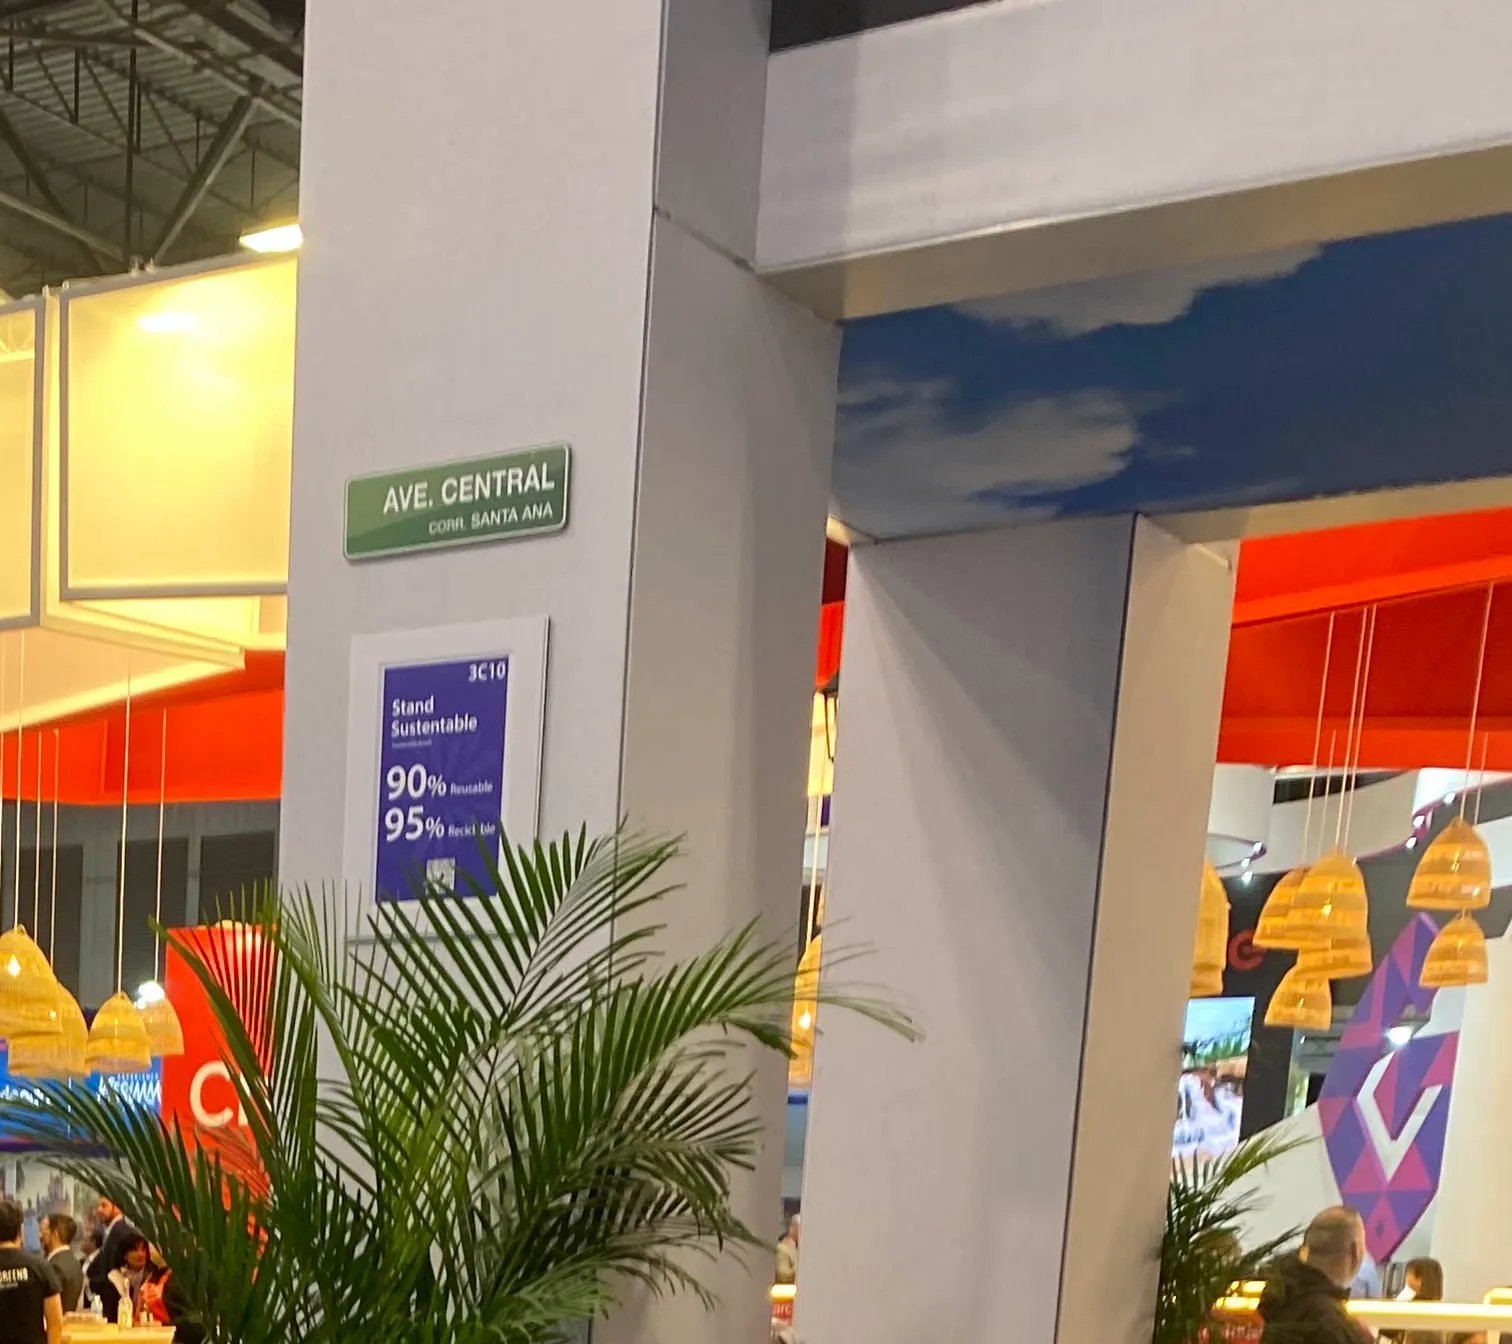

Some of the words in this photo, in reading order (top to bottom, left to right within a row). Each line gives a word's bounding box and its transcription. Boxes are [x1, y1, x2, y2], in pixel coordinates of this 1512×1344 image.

[383, 481, 434, 516] AVE.
[441, 462, 555, 507] CENTRAL
[471, 506, 519, 531] SANTA
[522, 501, 553, 521] ANA
[392, 693, 434, 717] Stand
[391, 712, 478, 738] Sustentable
[386, 763, 447, 801] 90%
[384, 804, 445, 842] 95%
